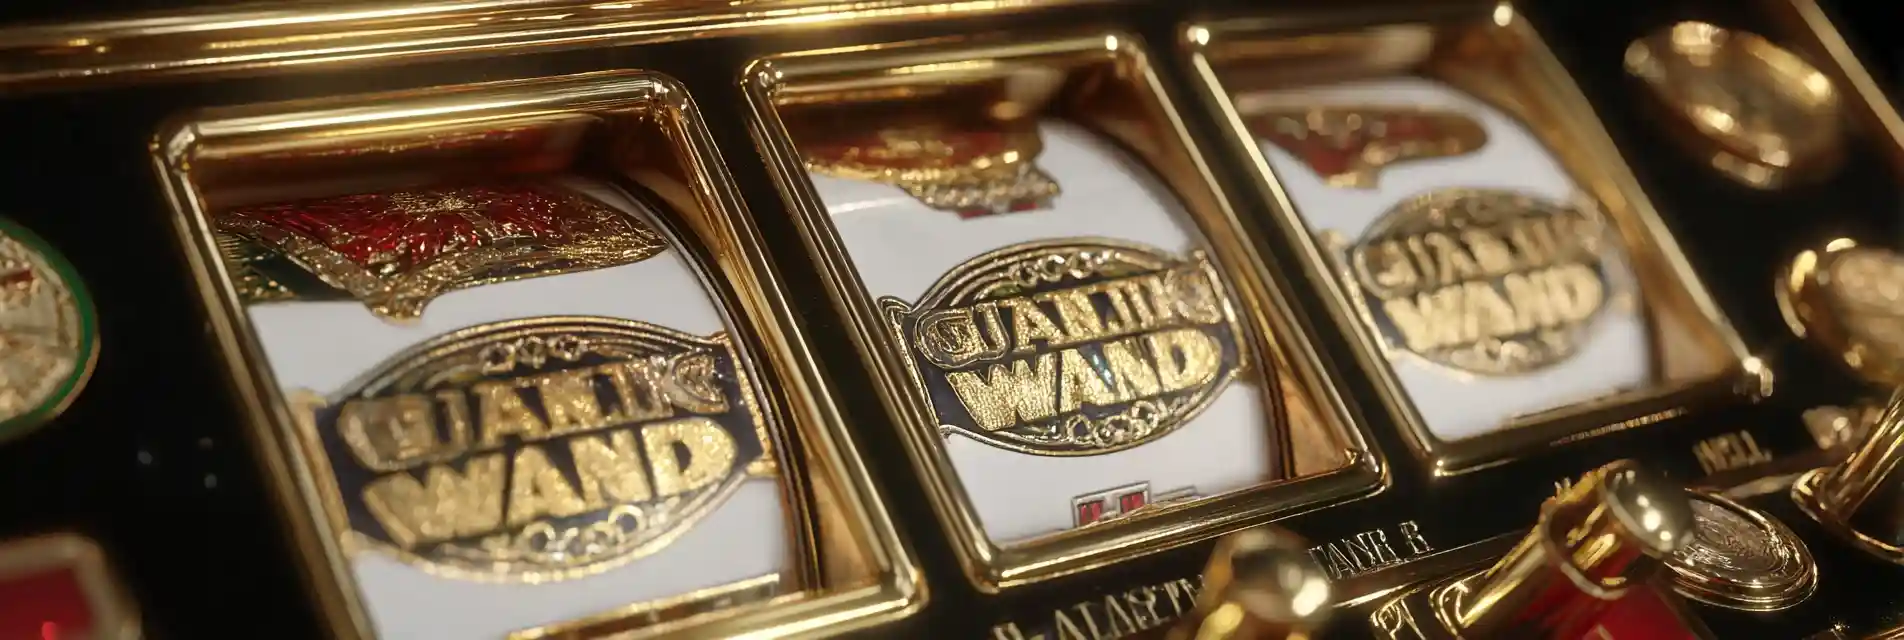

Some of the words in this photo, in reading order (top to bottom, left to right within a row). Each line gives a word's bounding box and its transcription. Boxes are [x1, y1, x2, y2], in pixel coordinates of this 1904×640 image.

[1383, 264, 1603, 353] WAND
[945, 328, 1221, 432] WAND
[361, 417, 738, 550] WAND
